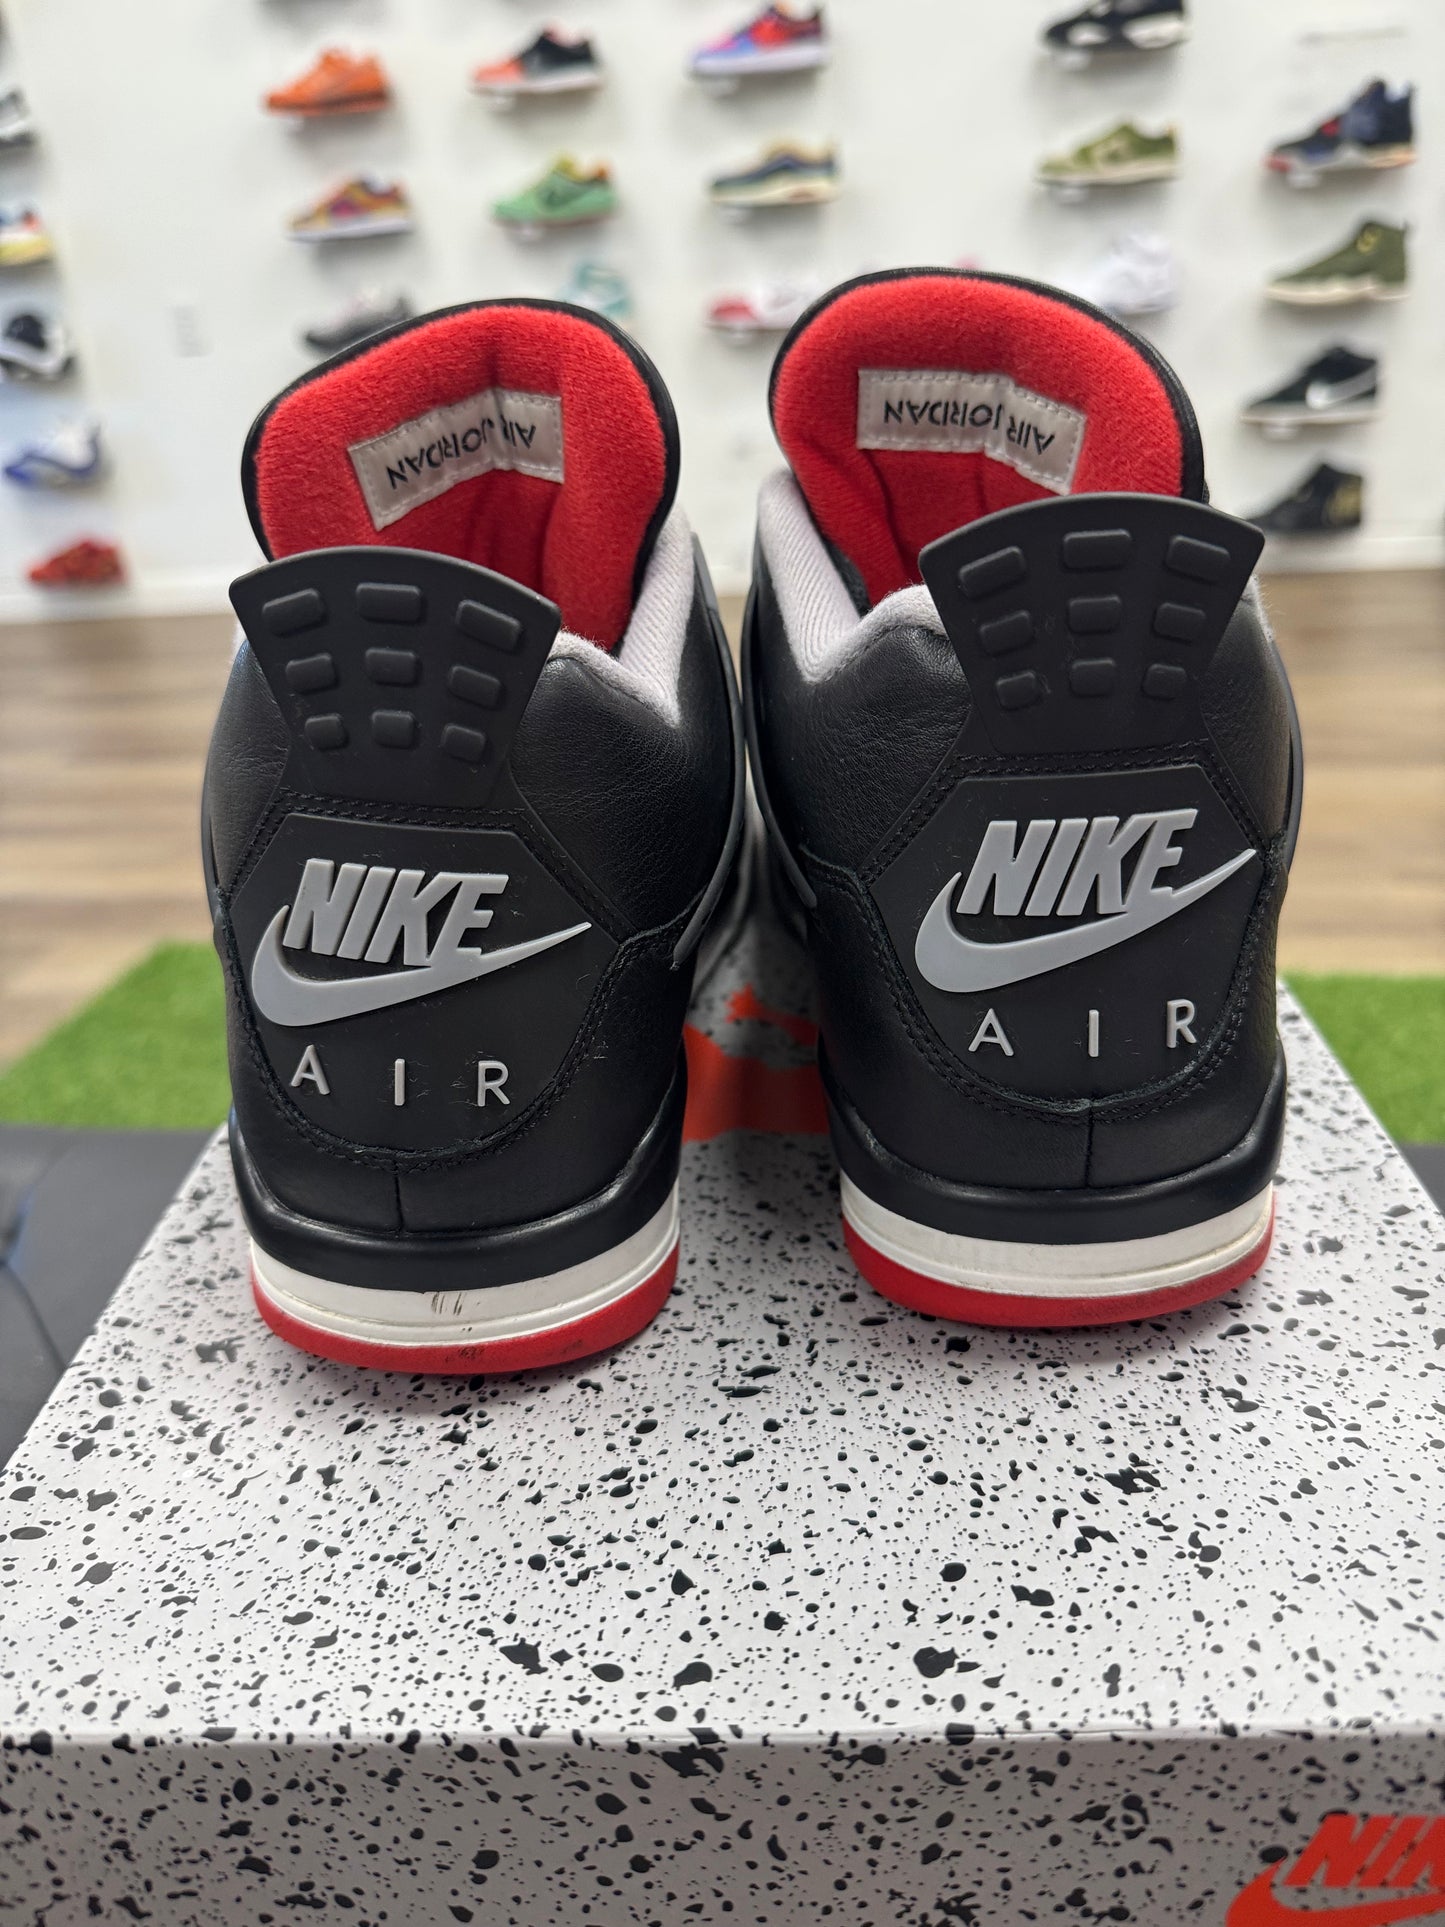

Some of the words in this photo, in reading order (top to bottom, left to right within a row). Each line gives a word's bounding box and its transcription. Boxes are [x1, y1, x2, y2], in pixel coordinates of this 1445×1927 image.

[883, 399, 1004, 430] JORDAN
[1006, 415, 1055, 456] AIR
[385, 417, 494, 490] JORDAN
[956, 808, 1198, 916] NIKE
[282, 857, 509, 968] NIKE
[967, 998, 1197, 1058] AIR
[290, 1044, 510, 1107] AIR
